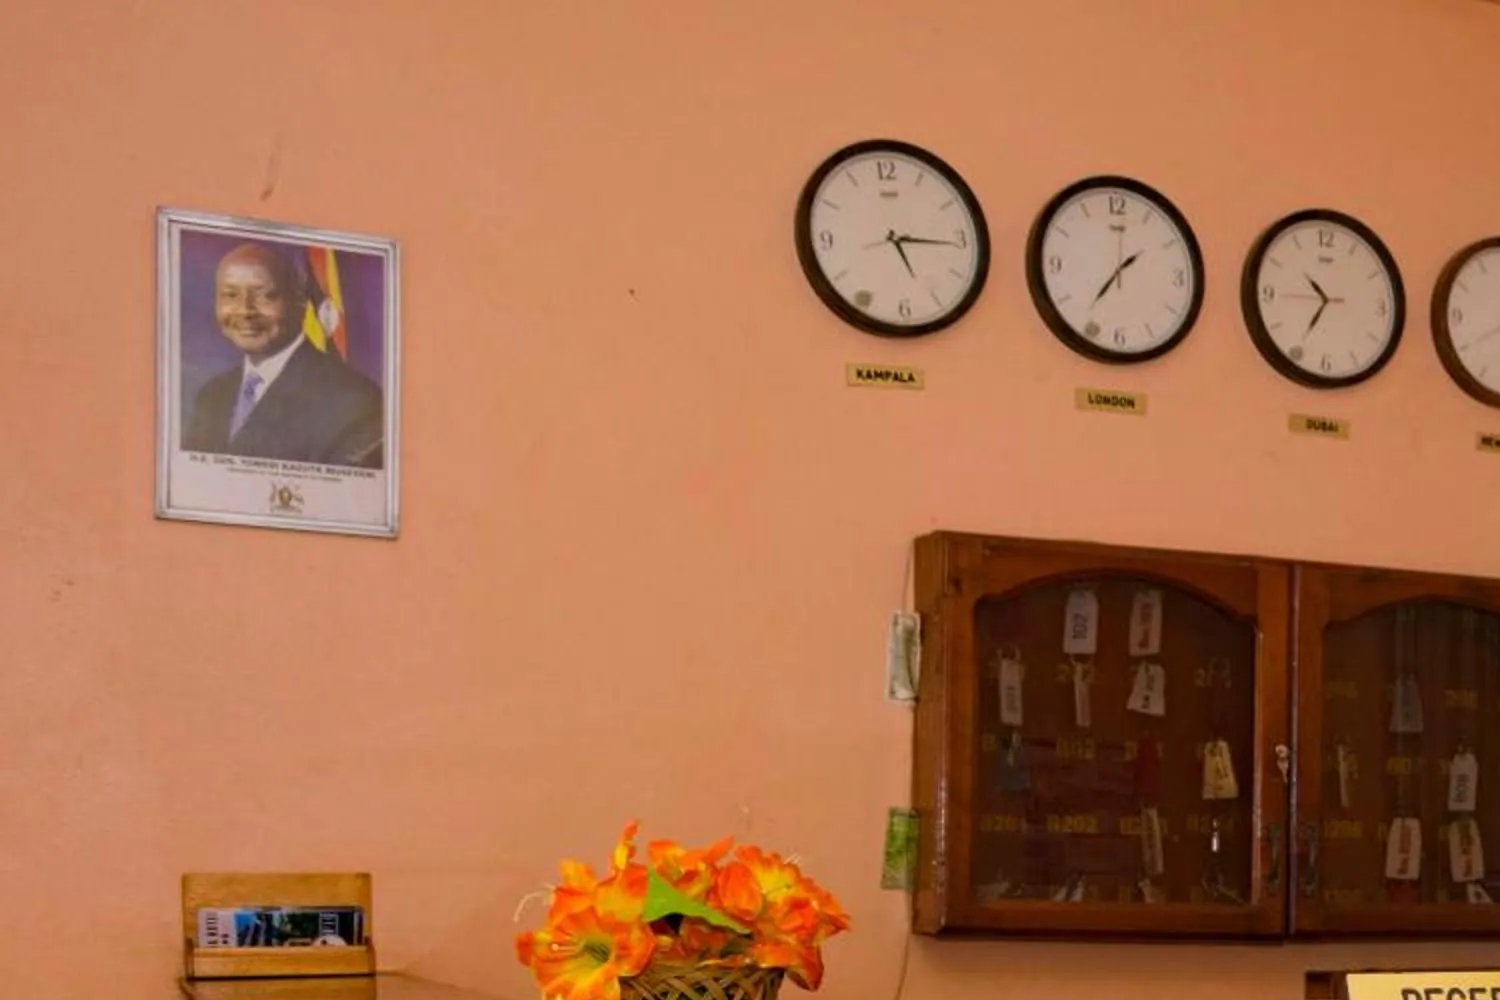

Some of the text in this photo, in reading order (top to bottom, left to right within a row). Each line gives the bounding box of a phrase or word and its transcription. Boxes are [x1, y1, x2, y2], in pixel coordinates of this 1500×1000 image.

[876, 159, 898, 181] 12
[1108, 194, 1127, 216] 12
[818, 231, 834, 251] 9
[952, 230, 967, 250] 3
[1317, 228, 1337, 249] 12
[1048, 256, 1063, 274] 9
[1172, 269, 1185, 287] 3
[1262, 286, 1275, 303] 9
[898, 298, 912, 318] 6
[1376, 297, 1388, 318] 3
[1450, 307, 1463, 324] 9
[1113, 328, 1127, 347] 6
[1319, 354, 1333, 374] 6
[855, 369, 917, 383] KAMPALA
[1086, 391, 1136, 409] LONDON
[1306, 418, 1340, 433] DUBAI
